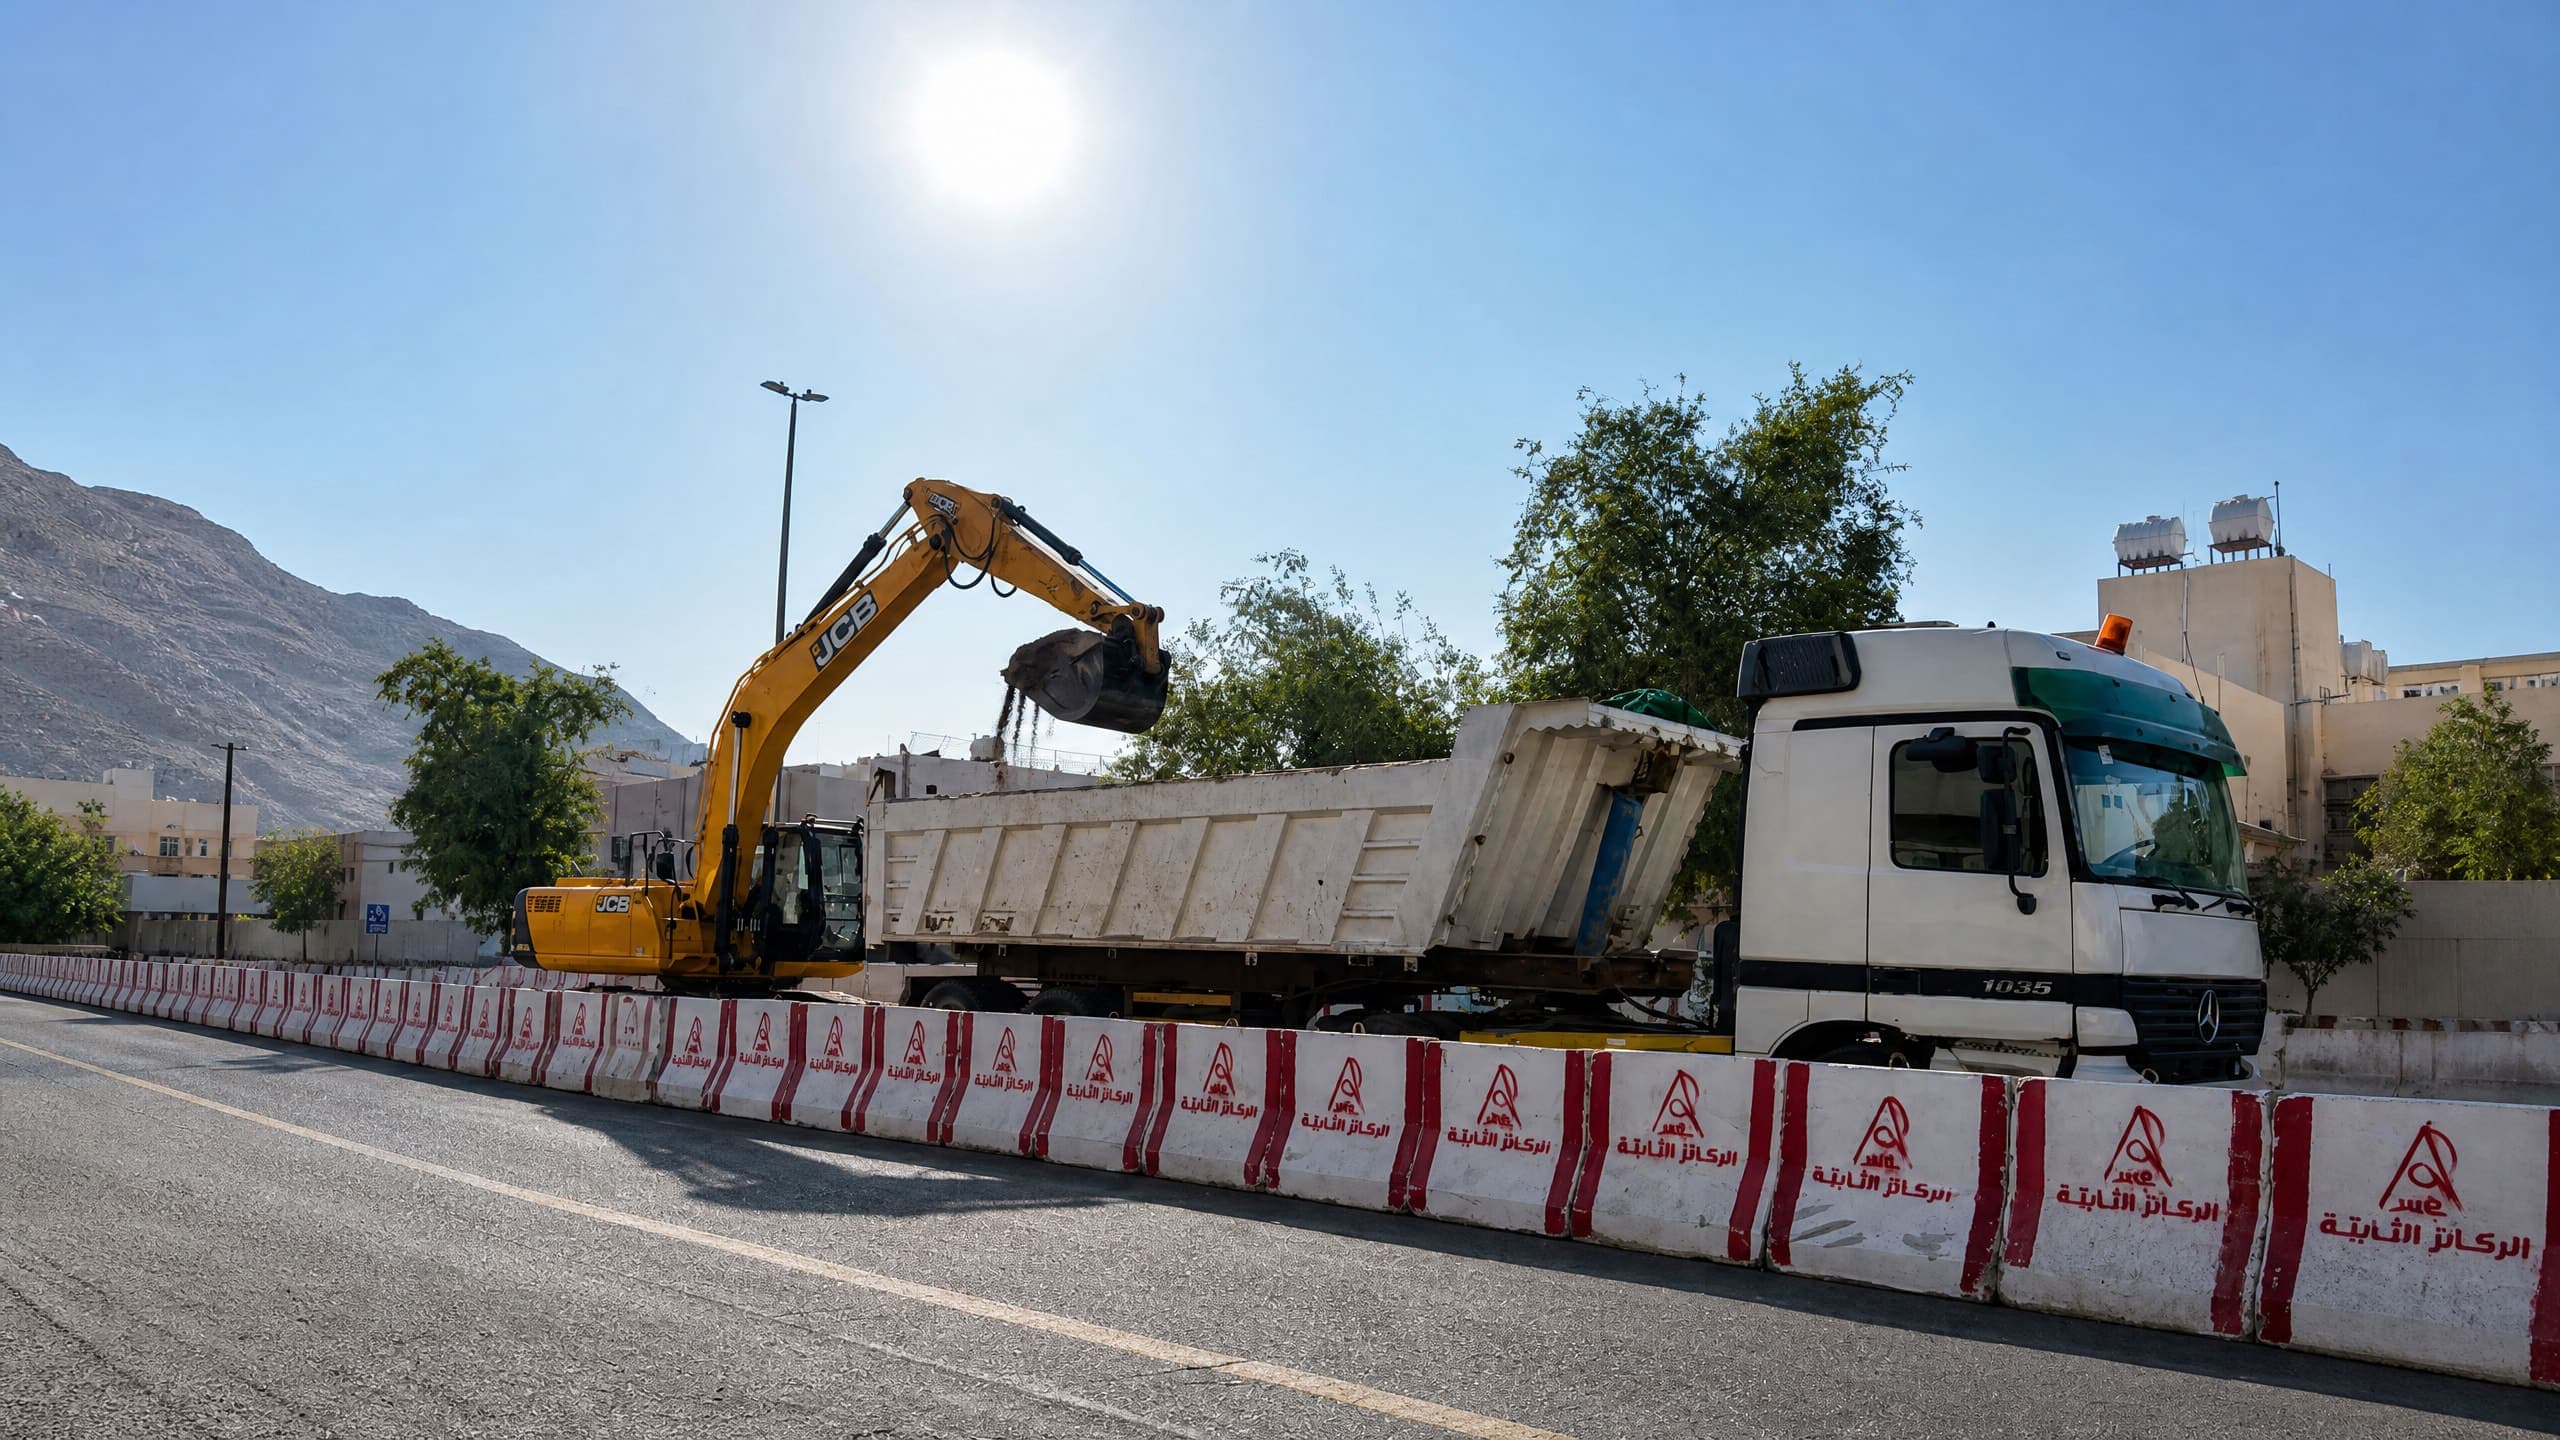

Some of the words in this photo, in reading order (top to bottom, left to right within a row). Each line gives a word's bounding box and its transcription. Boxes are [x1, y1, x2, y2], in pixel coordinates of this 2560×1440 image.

[816, 593, 878, 667] JCB
[596, 896, 630, 912] JCB
[1983, 979, 2053, 995] 1035
